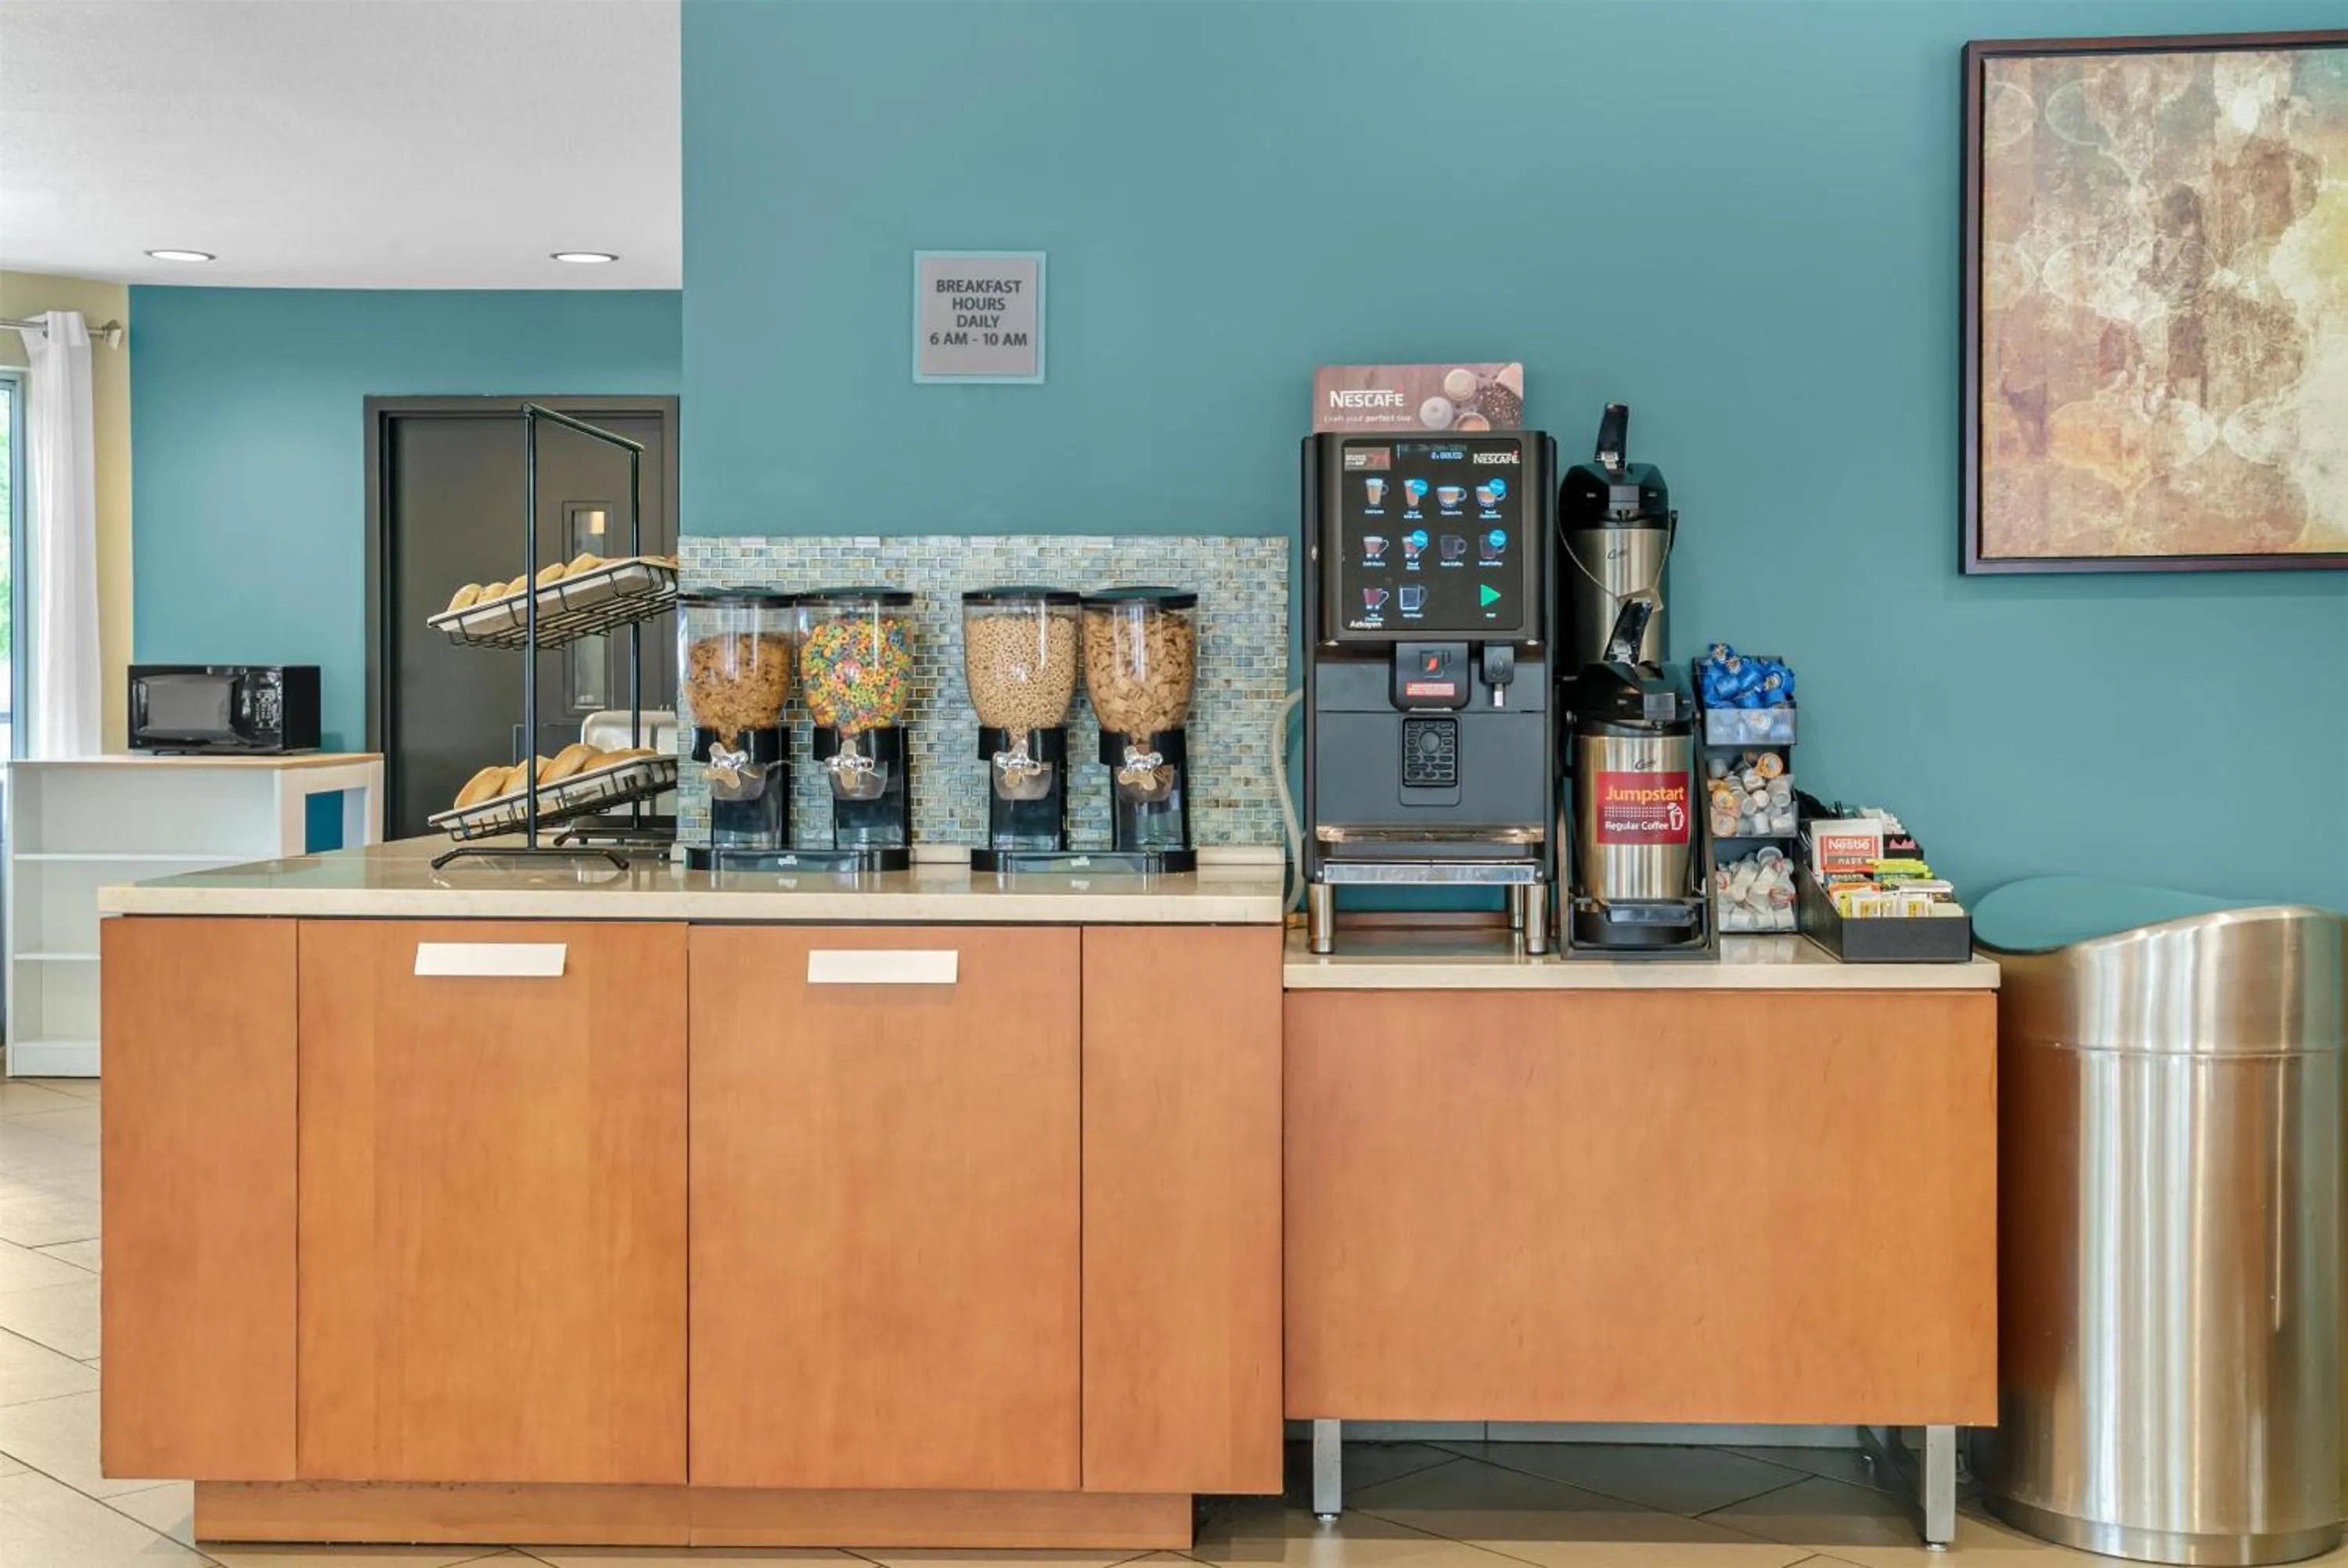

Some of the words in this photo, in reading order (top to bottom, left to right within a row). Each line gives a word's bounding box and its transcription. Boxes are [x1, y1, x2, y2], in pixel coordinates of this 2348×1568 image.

[936, 279, 1022, 293] BREAKFAST
[953, 297, 1006, 311] HOURS
[956, 315, 1000, 328] DAILY
[930, 333, 939, 345] 6
[943, 332, 968, 345] AM
[983, 333, 999, 346] 10
[1003, 333, 1028, 346] AM
[1605, 786, 1684, 805] Jumpstart
[1605, 821, 1639, 831] Regular
[1641, 821, 1669, 830] Coffee
